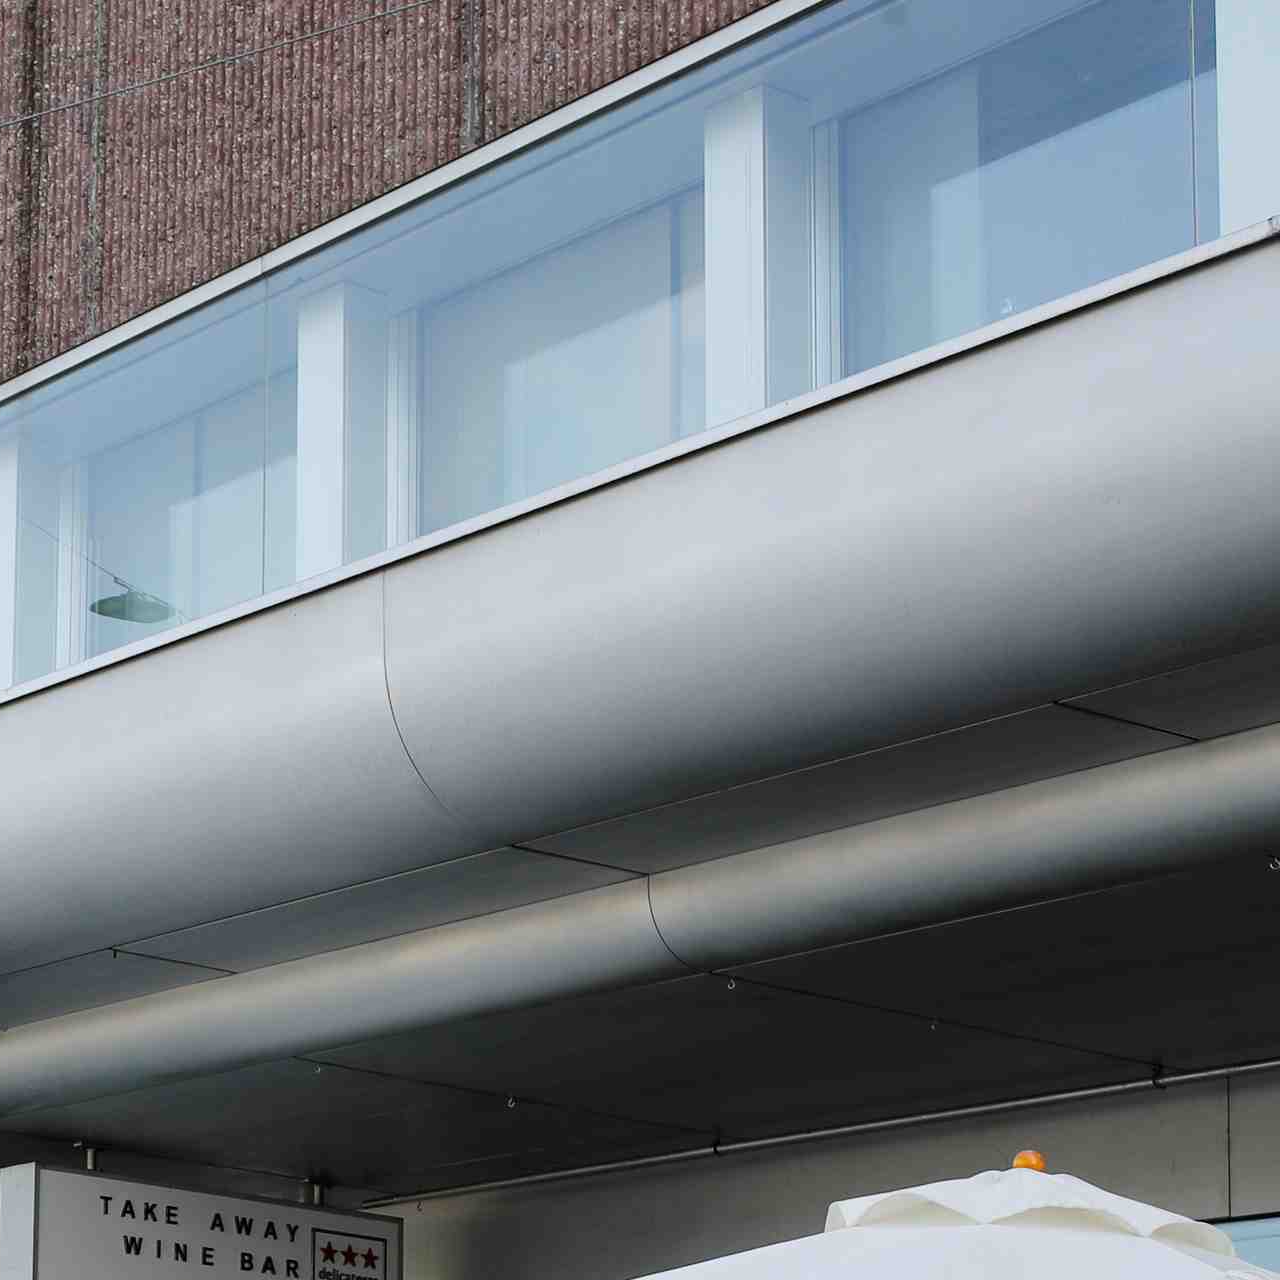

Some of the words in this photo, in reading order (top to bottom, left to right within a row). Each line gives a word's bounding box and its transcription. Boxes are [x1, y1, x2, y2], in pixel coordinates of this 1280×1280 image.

[99, 1196, 179, 1225] TAKE
[210, 1213, 300, 1243] AWAY
[123, 1235, 215, 1266] WINE
[240, 1252, 300, 1279] BAR
